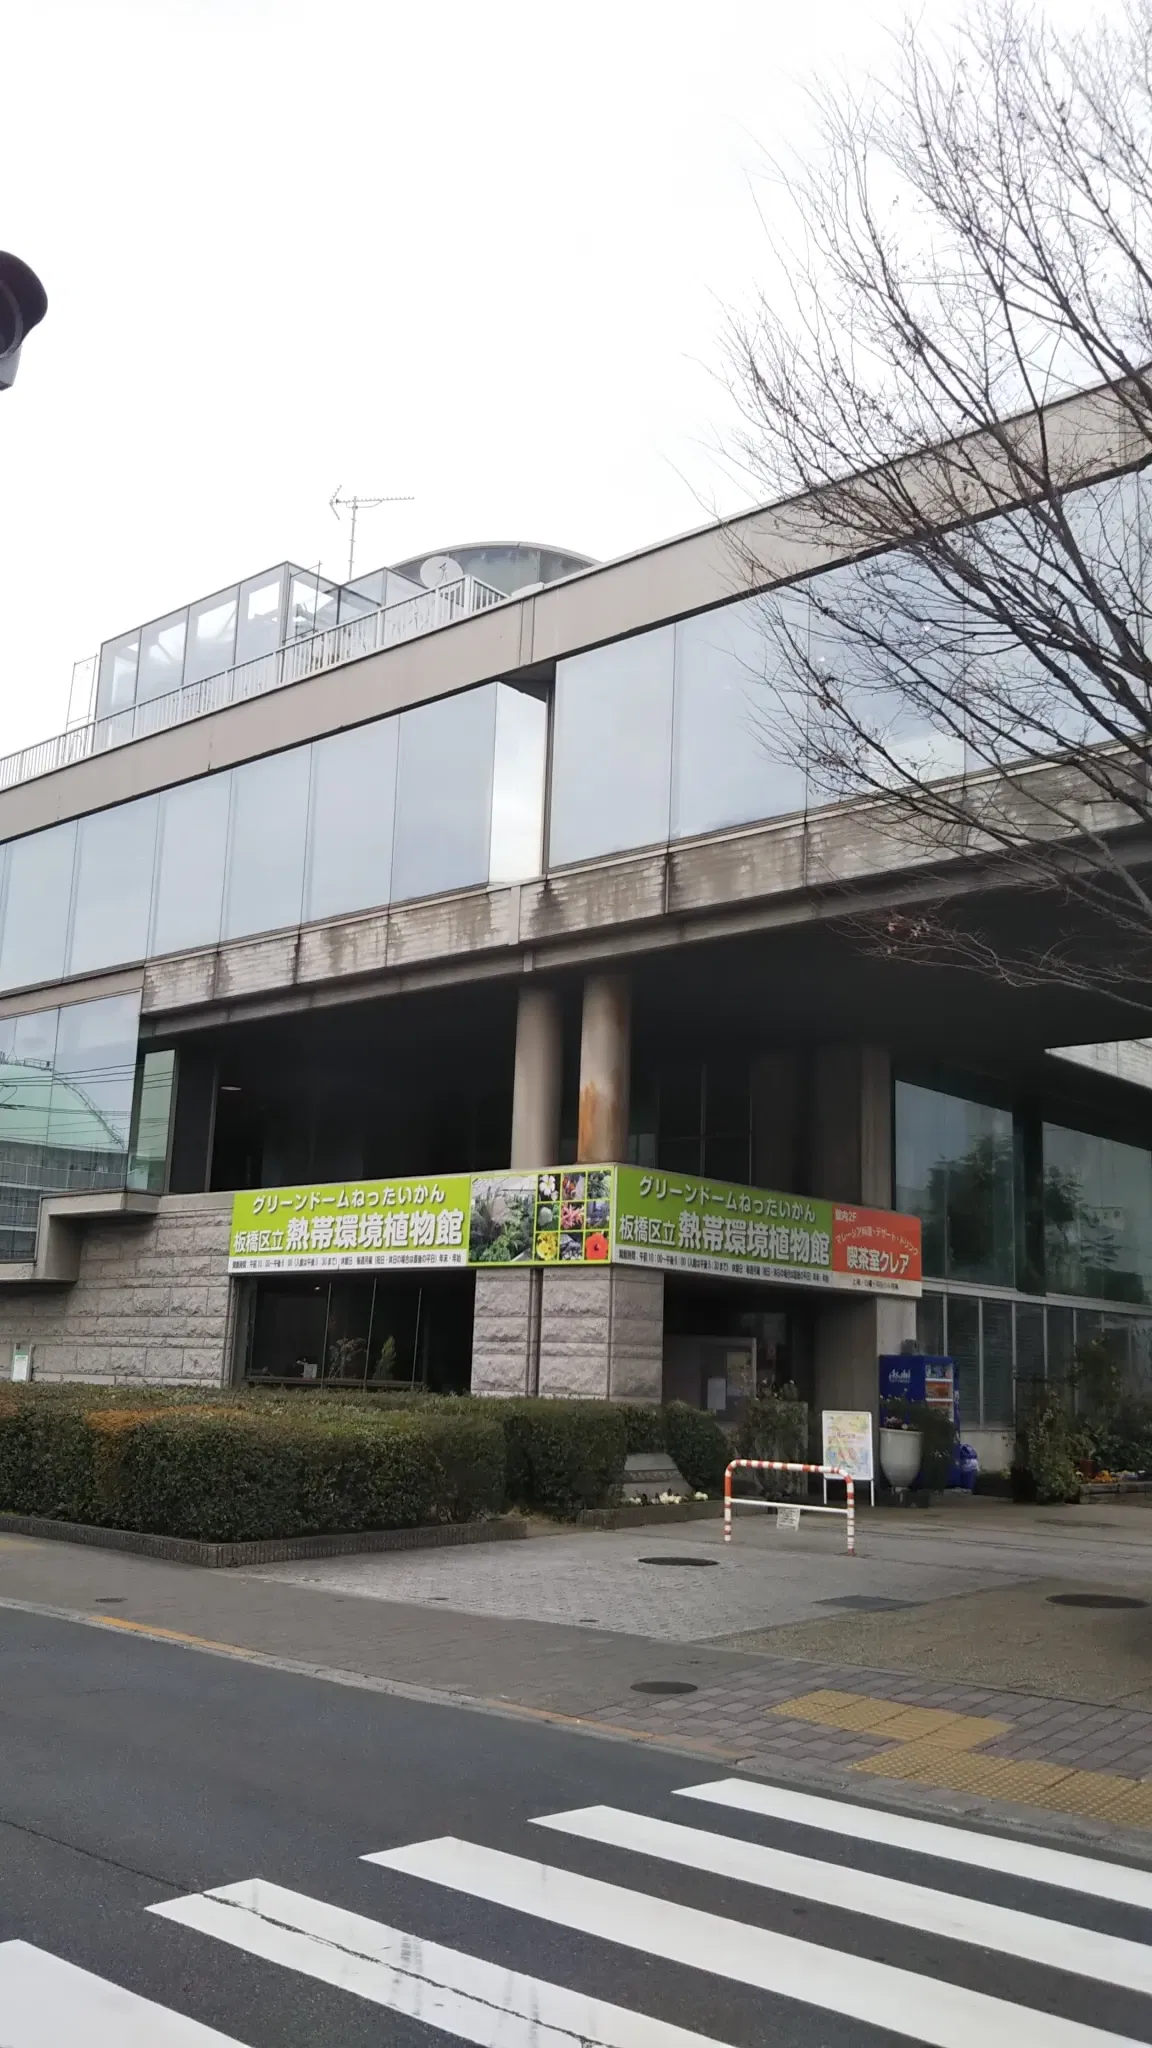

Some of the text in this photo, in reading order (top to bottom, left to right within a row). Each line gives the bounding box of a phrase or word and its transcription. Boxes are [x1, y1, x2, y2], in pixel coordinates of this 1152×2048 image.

[253, 1183, 446, 1214] グリーンドームねったいかん
[639, 1175, 817, 1223] グリーンドームねったいかん
[233, 1209, 465, 1254] 板橋区立 熱帯環境植物館
[619, 1209, 830, 1266] 板橋区立 熱帯環境植物館
[847, 1244, 909, 1275] 喫茶室クレア
